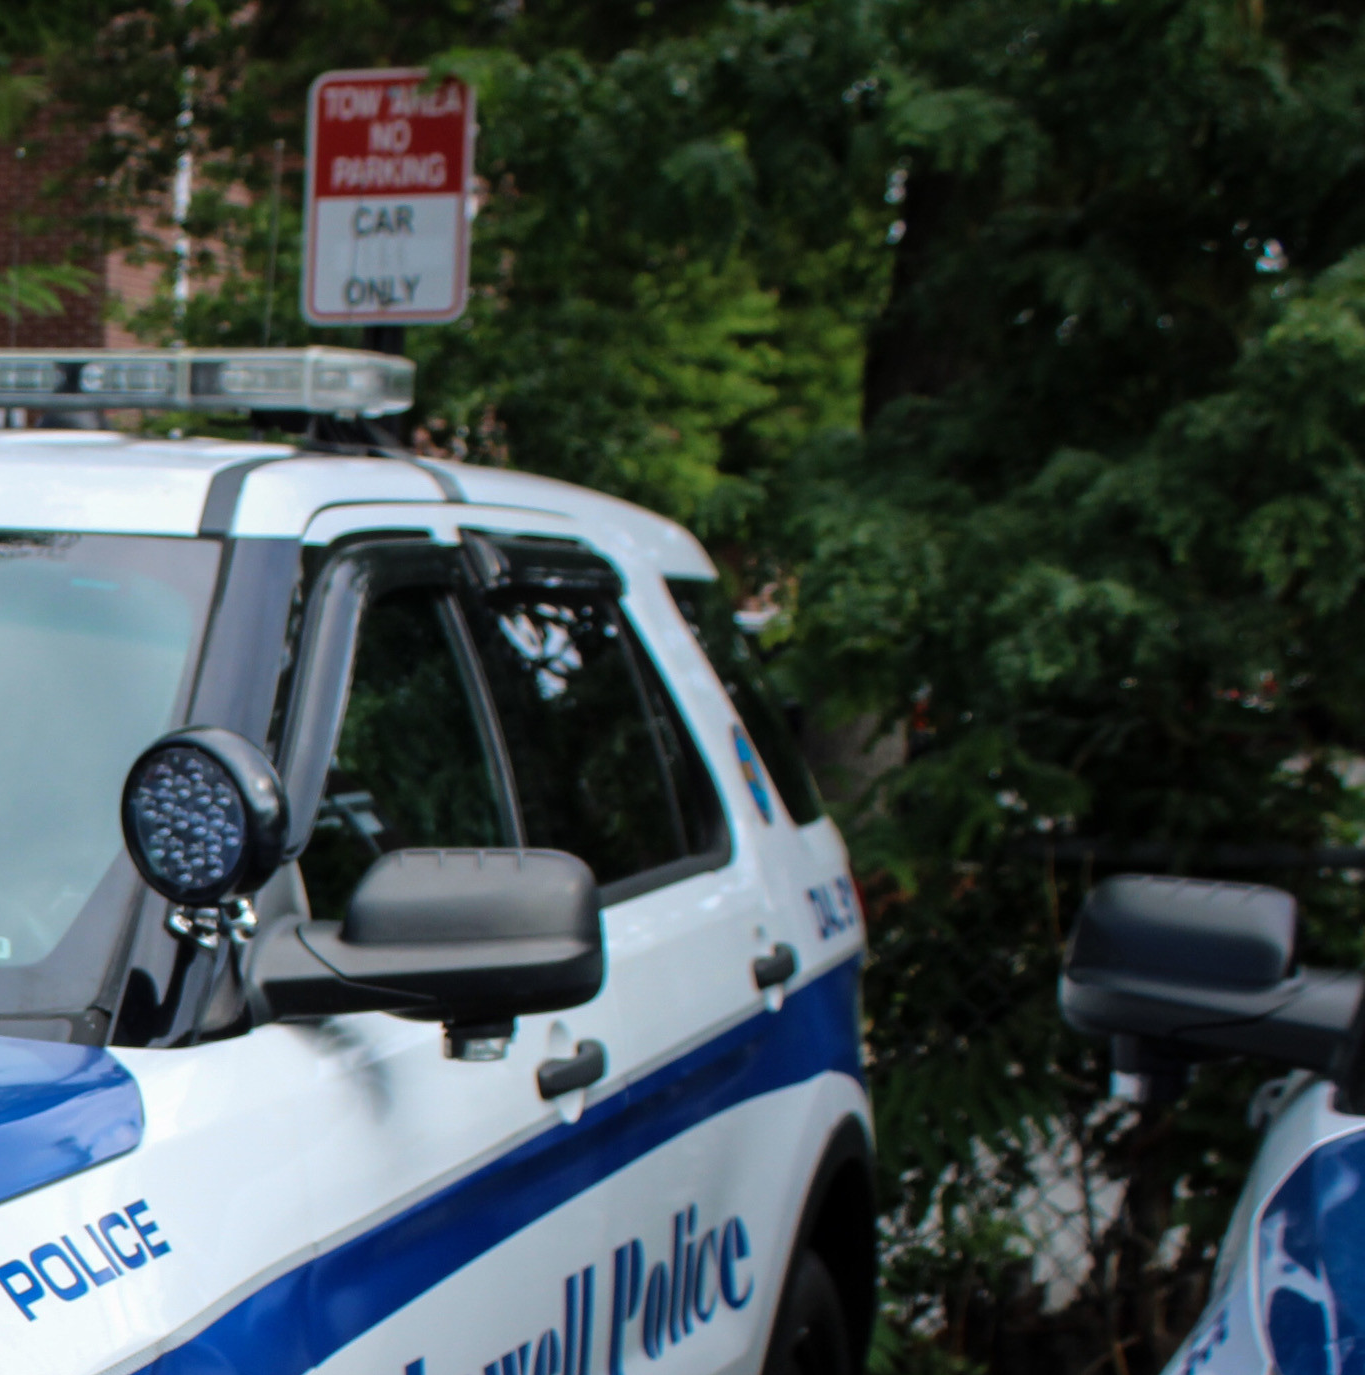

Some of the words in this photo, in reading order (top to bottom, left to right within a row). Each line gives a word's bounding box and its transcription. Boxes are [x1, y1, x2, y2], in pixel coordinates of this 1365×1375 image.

[324, 87, 379, 119] TOW
[368, 121, 412, 152] NO
[331, 154, 447, 188] PARKING
[354, 205, 414, 237] CAR
[343, 275, 421, 306] ONLY
